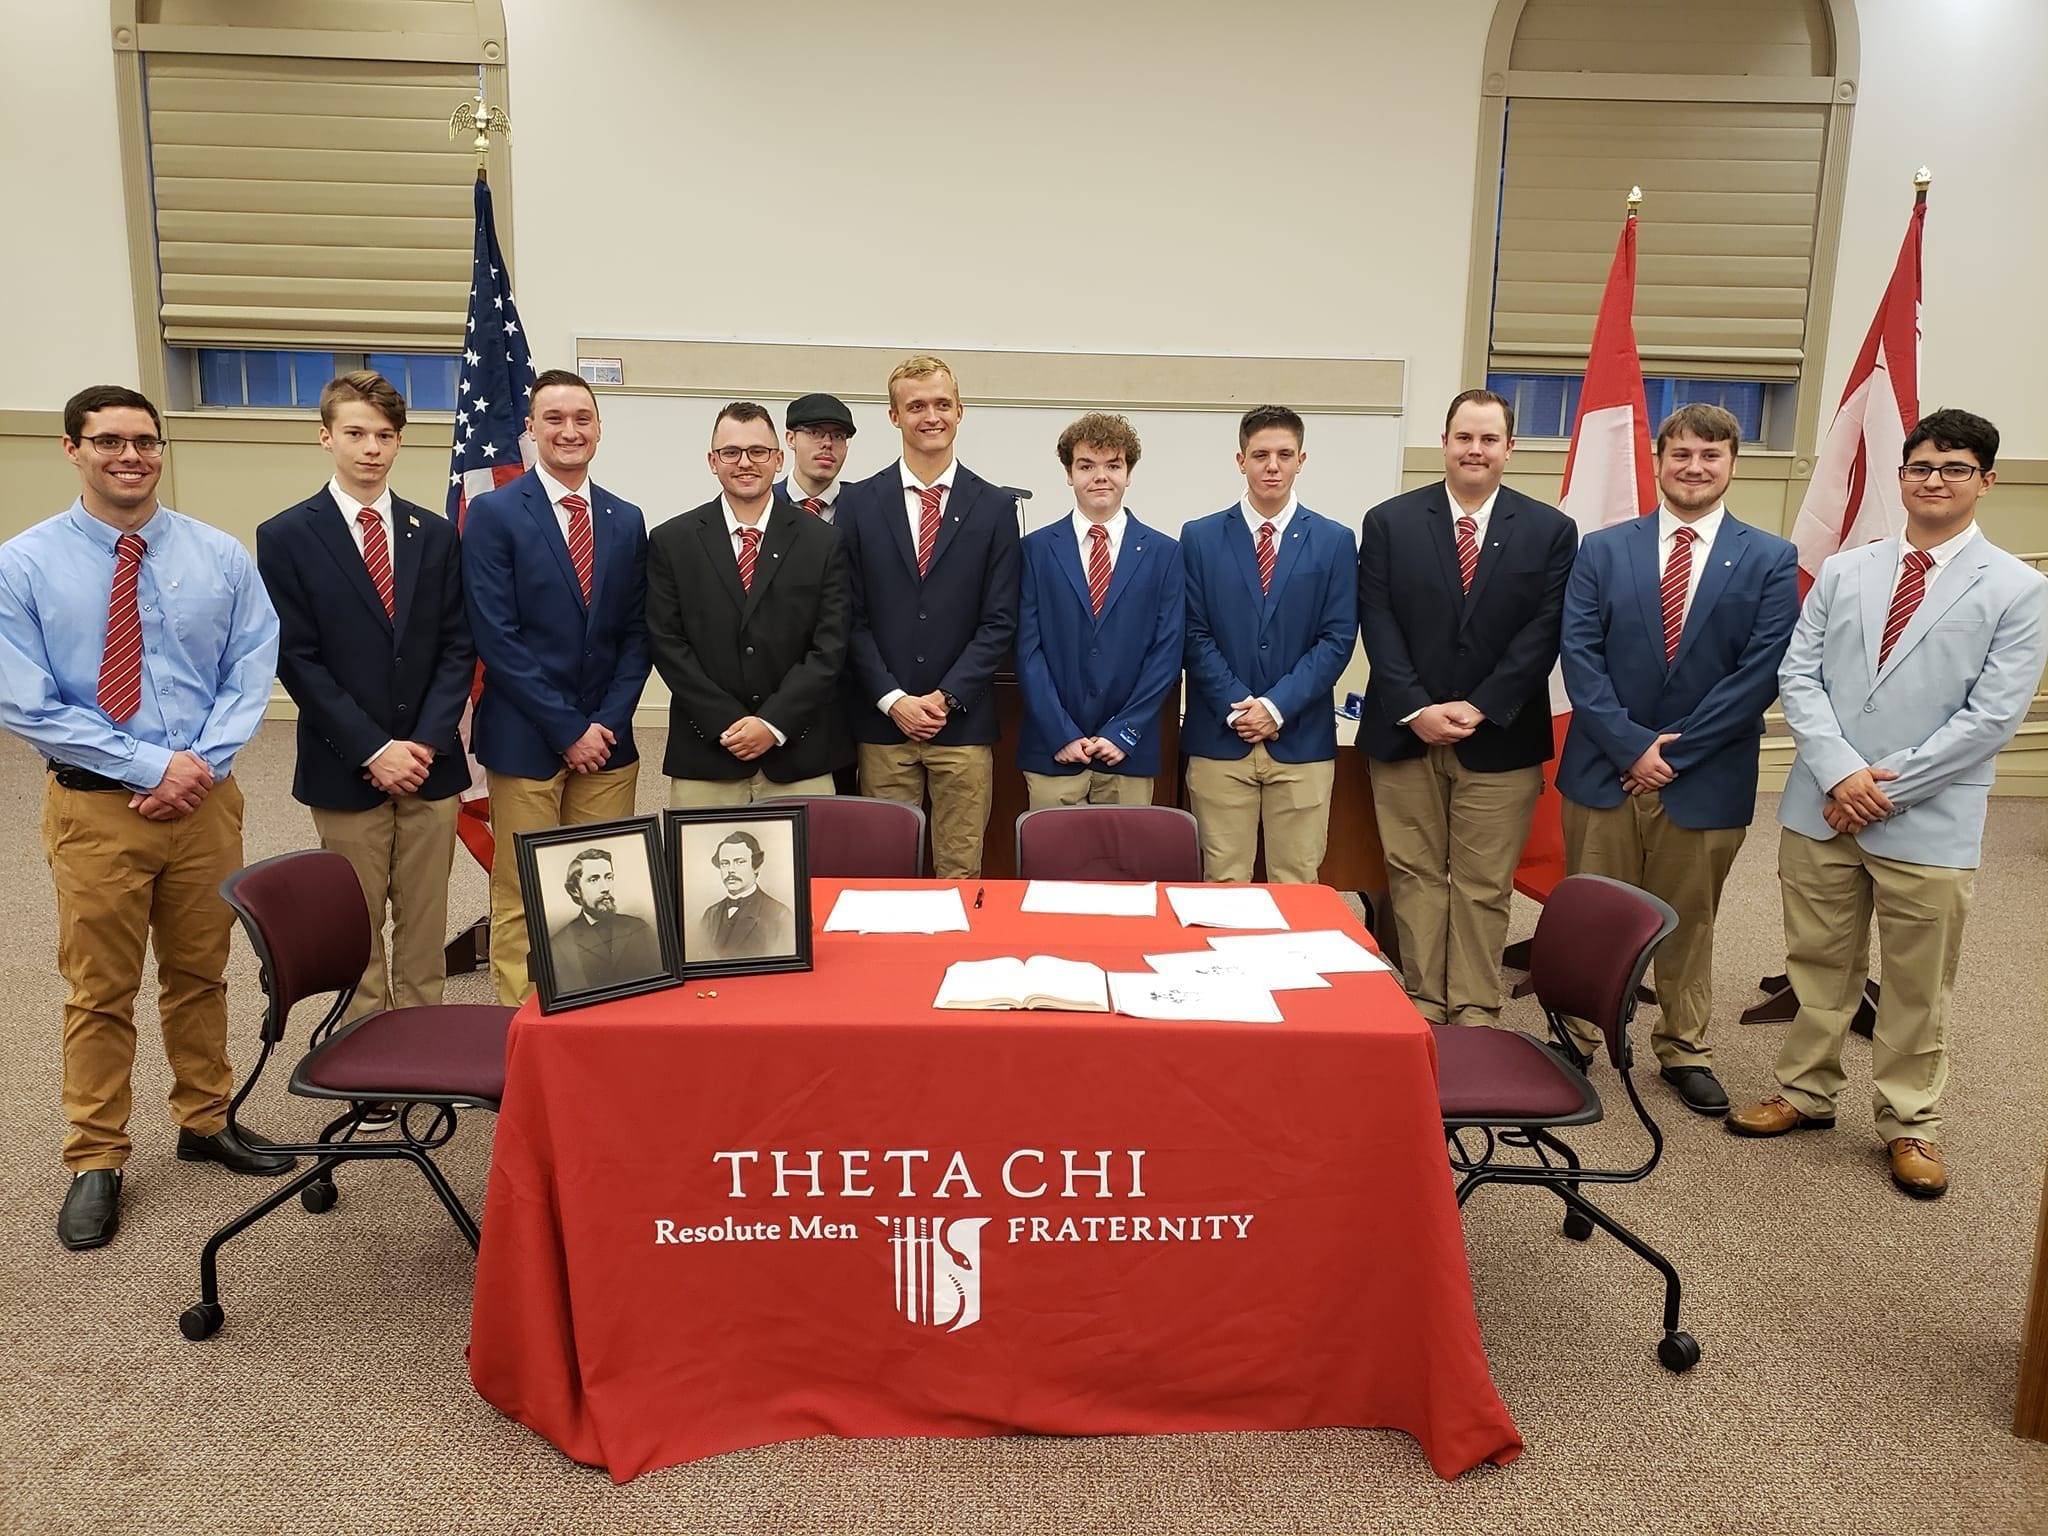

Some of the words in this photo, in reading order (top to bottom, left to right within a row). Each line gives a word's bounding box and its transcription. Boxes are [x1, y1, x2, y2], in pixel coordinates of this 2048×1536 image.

[713, 1150, 981, 1198] THETA
[1002, 1149, 1145, 1197] CHI
[655, 1216, 780, 1244] Resolute
[790, 1216, 858, 1239] Men
[1008, 1215, 1253, 1243] FRATERNITY
